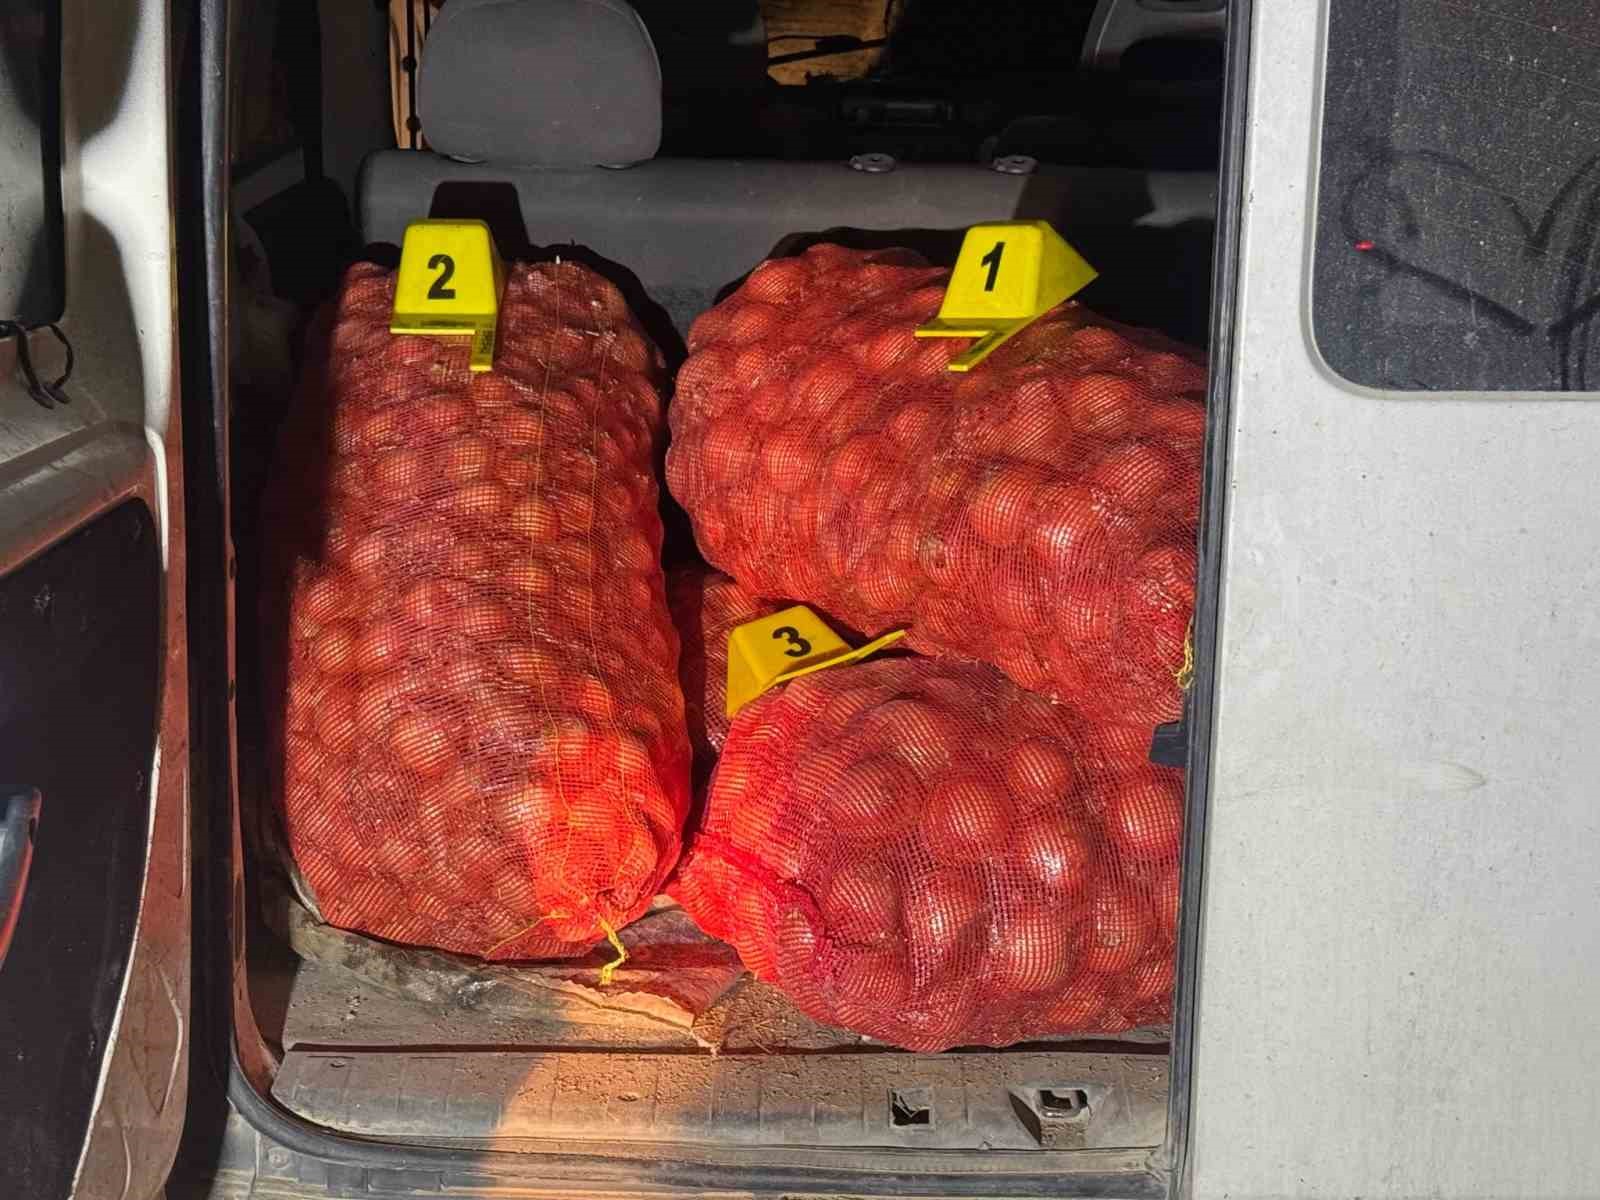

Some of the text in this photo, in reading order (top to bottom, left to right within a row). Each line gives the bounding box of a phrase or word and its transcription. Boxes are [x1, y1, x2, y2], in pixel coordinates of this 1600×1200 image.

[427, 253, 456, 300] 2
[981, 241, 1006, 292] 1
[772, 625, 812, 658] 3
